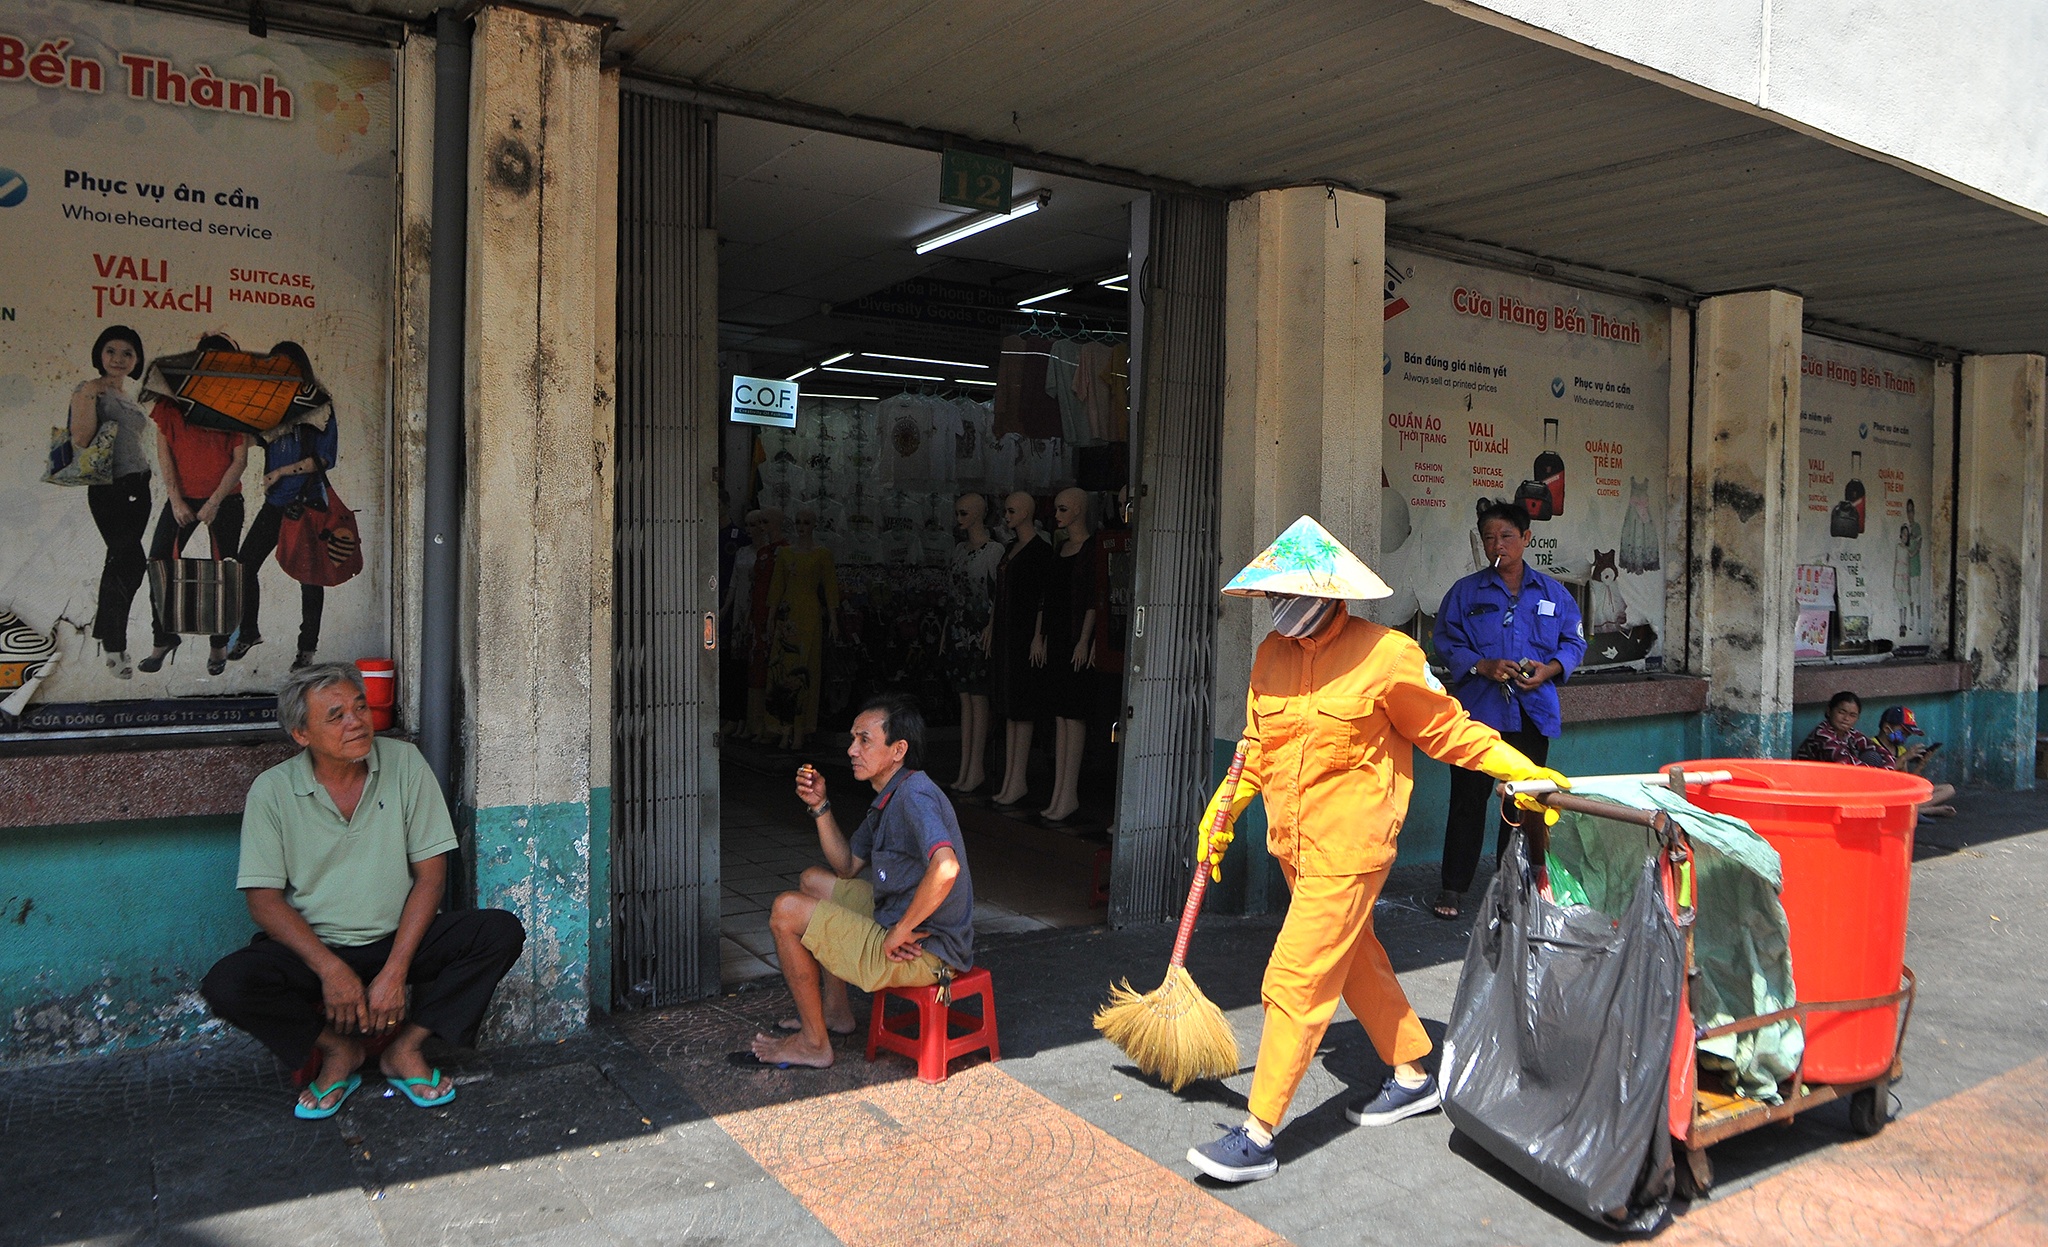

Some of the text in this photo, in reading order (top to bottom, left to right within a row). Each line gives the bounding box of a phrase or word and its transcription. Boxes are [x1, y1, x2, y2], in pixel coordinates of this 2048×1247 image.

[0, 37, 291, 118] Bến Thành
[65, 170, 259, 210] Phục vụ ân cần
[951, 171, 1001, 208] 12
[209, 222, 272, 240] service
[93, 253, 168, 283] VALI
[230, 268, 315, 290] SUITCASE,
[92, 284, 212, 318] TÚI XÁCH
[229, 289, 315, 309] HANDBAG
[859, 297, 922, 319] Diversity
[927, 304, 972, 322] Goods
[1453, 288, 1640, 343] Cửa Hàng Bến Thành
[1404, 351, 1507, 378] Bán đúng giá niêm yết
[1403, 371, 1497, 393] Always sell at printed prices
[1574, 377, 1593, 391] Phục
[1595, 382, 1604, 393] vụ
[735, 384, 794, 410] C.O.F.
[1388, 411, 1442, 430] QUẦN ÁO
[1468, 421, 1494, 438] VALI
[1399, 430, 1447, 453] THỜI TRANG
[1468, 438, 1508, 458] TÚI XÁCH
[1611, 441, 1623, 455] ÁO
[1415, 462, 1443, 472] FASHION
[1610, 457, 1623, 469] EM
[1808, 458, 1825, 471] VALI
[1412, 474, 1445, 484] CLOTHING
[1473, 478, 1504, 488] HANDBAG
[1595, 477, 1621, 487] CHILDREN
[1426, 486, 1431, 495] &
[1410, 498, 1446, 508] GARMENTS
[1538, 538, 1558, 549] CHƠI
[1535, 550, 1553, 565] TRẺ
[1548, 566, 1571, 574] EM
[32, 713, 61, 726] CỬA
[65, 712, 105, 725] ĐÔNG
[113, 713, 133, 724] (Từ
[136, 712, 159, 723] cửa
[163, 710, 178, 721] số
[181, 711, 195, 720] 11
[206, 709, 221, 720] số
[223, 710, 242, 721] 13)
